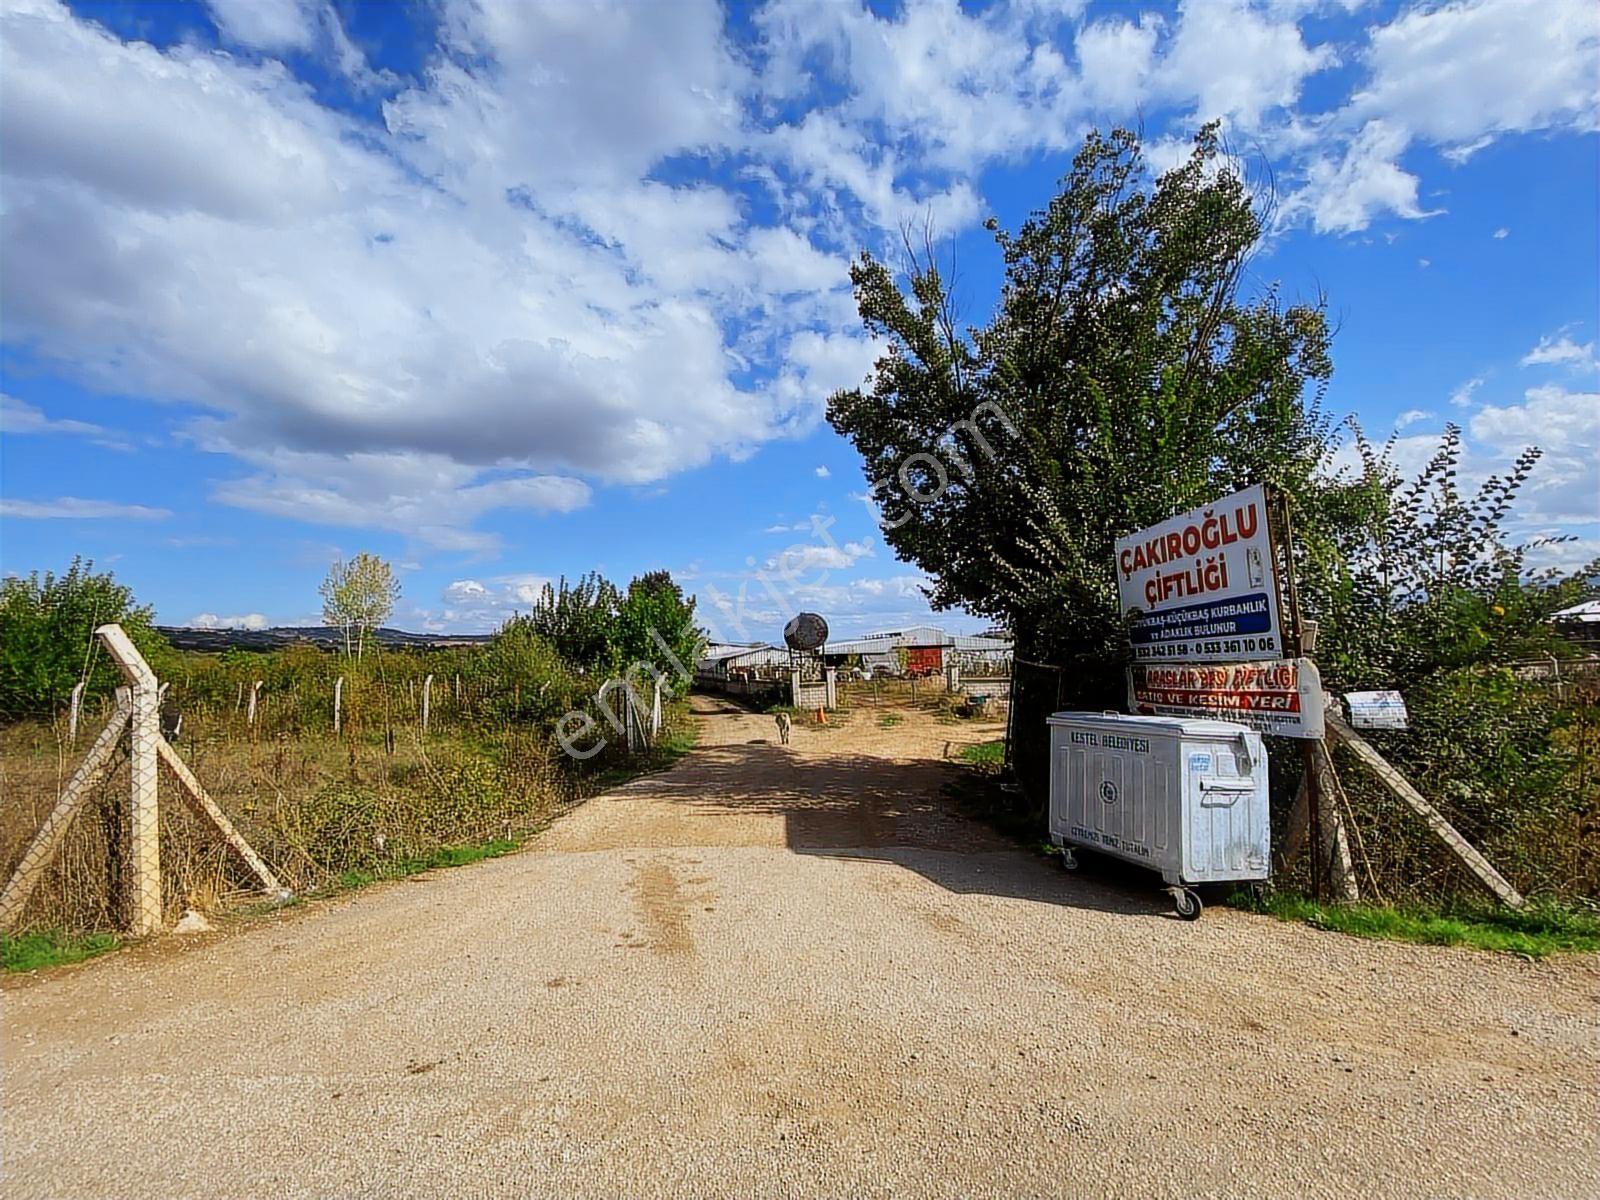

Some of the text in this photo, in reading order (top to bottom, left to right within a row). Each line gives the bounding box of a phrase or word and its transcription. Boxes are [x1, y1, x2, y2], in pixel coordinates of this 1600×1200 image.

[1120, 503, 1258, 582] ÇAKIROĞLU
[1145, 552, 1229, 609] ÇİFTLİĞİ
[1211, 599, 1268, 619] KURBANLIK
[1194, 621, 1237, 637] BULUNUR
[1195, 642, 1203, 654] 0
[1204, 641, 1221, 654] 533
[1223, 640, 1241, 653] 361
[1242, 638, 1256, 652] 10
[1258, 637, 1275, 651] 06
[1168, 693, 1184, 704] VE
[1188, 692, 1240, 707] KESİM
[1247, 693, 1292, 709] YERİ
